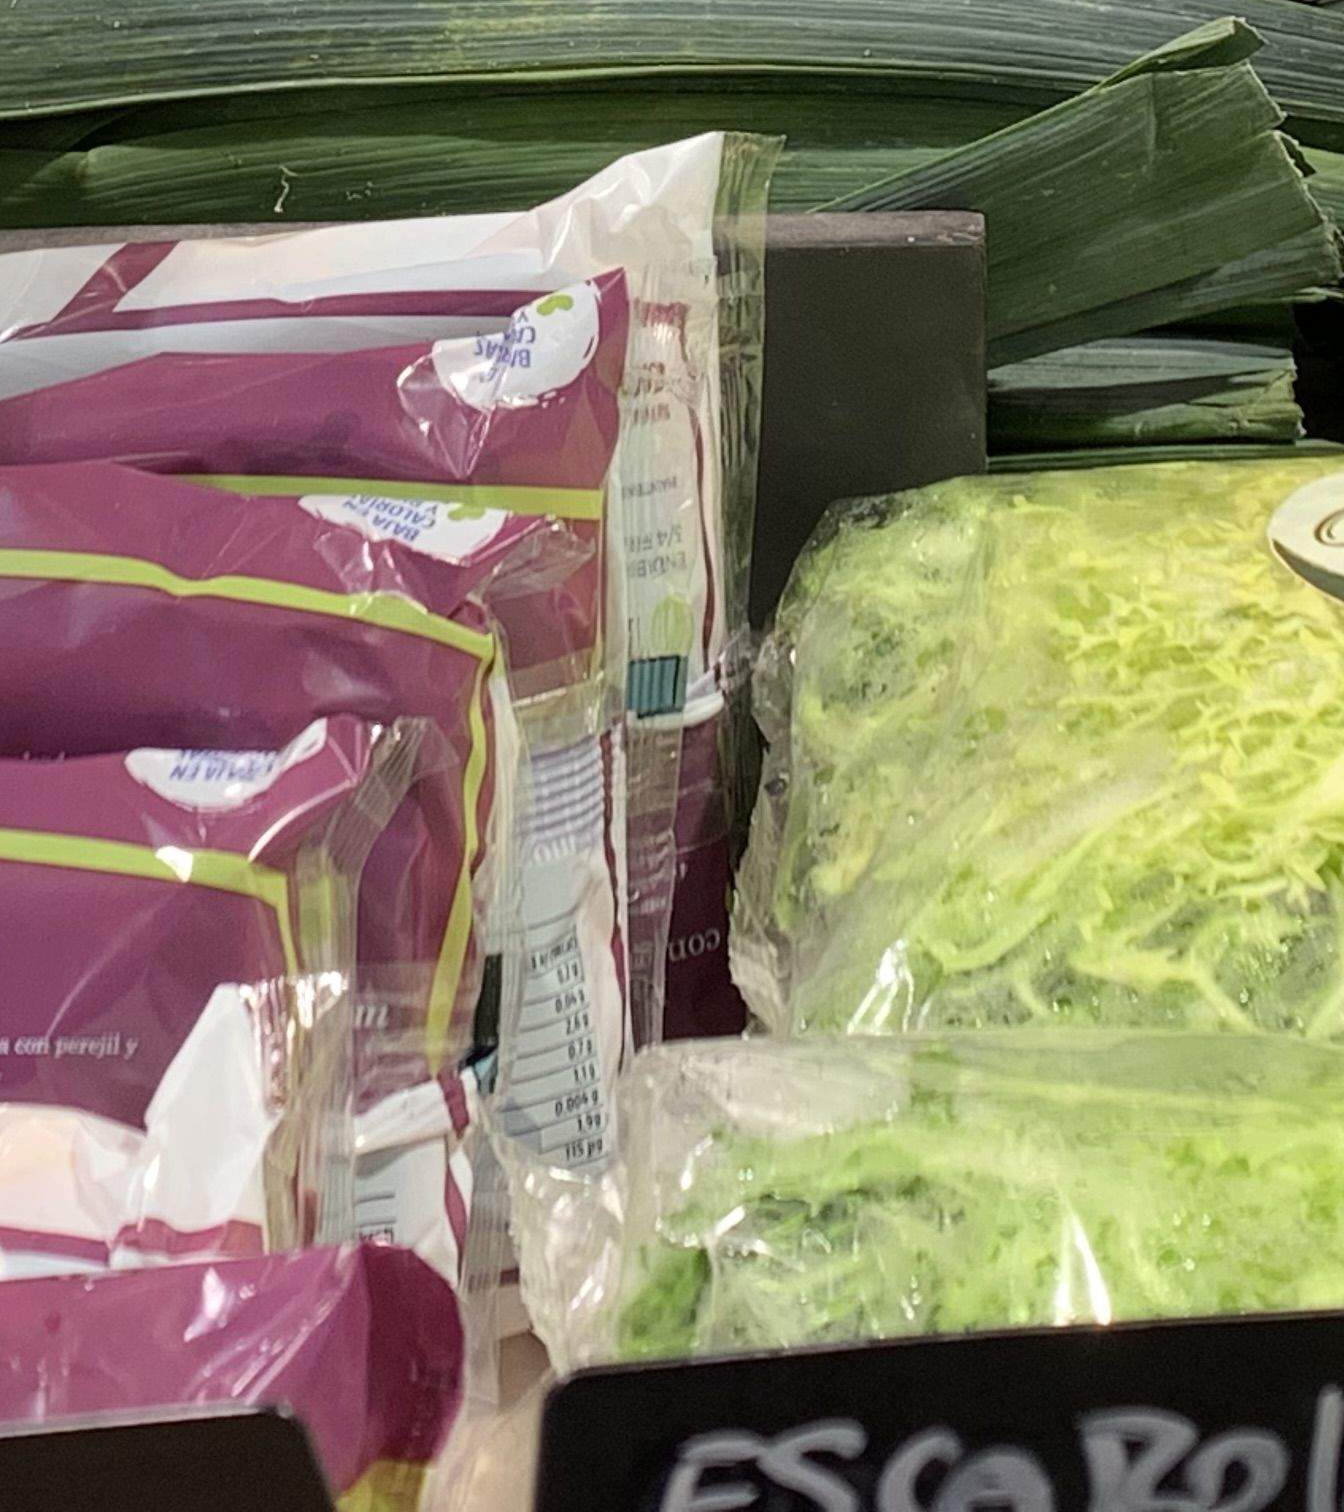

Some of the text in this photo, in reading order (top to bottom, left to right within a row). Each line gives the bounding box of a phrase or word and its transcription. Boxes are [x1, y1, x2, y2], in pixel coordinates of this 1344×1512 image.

[13, 1036, 51, 1056] con
[54, 1031, 122, 1060] perejil
[123, 1038, 139, 1061] y
